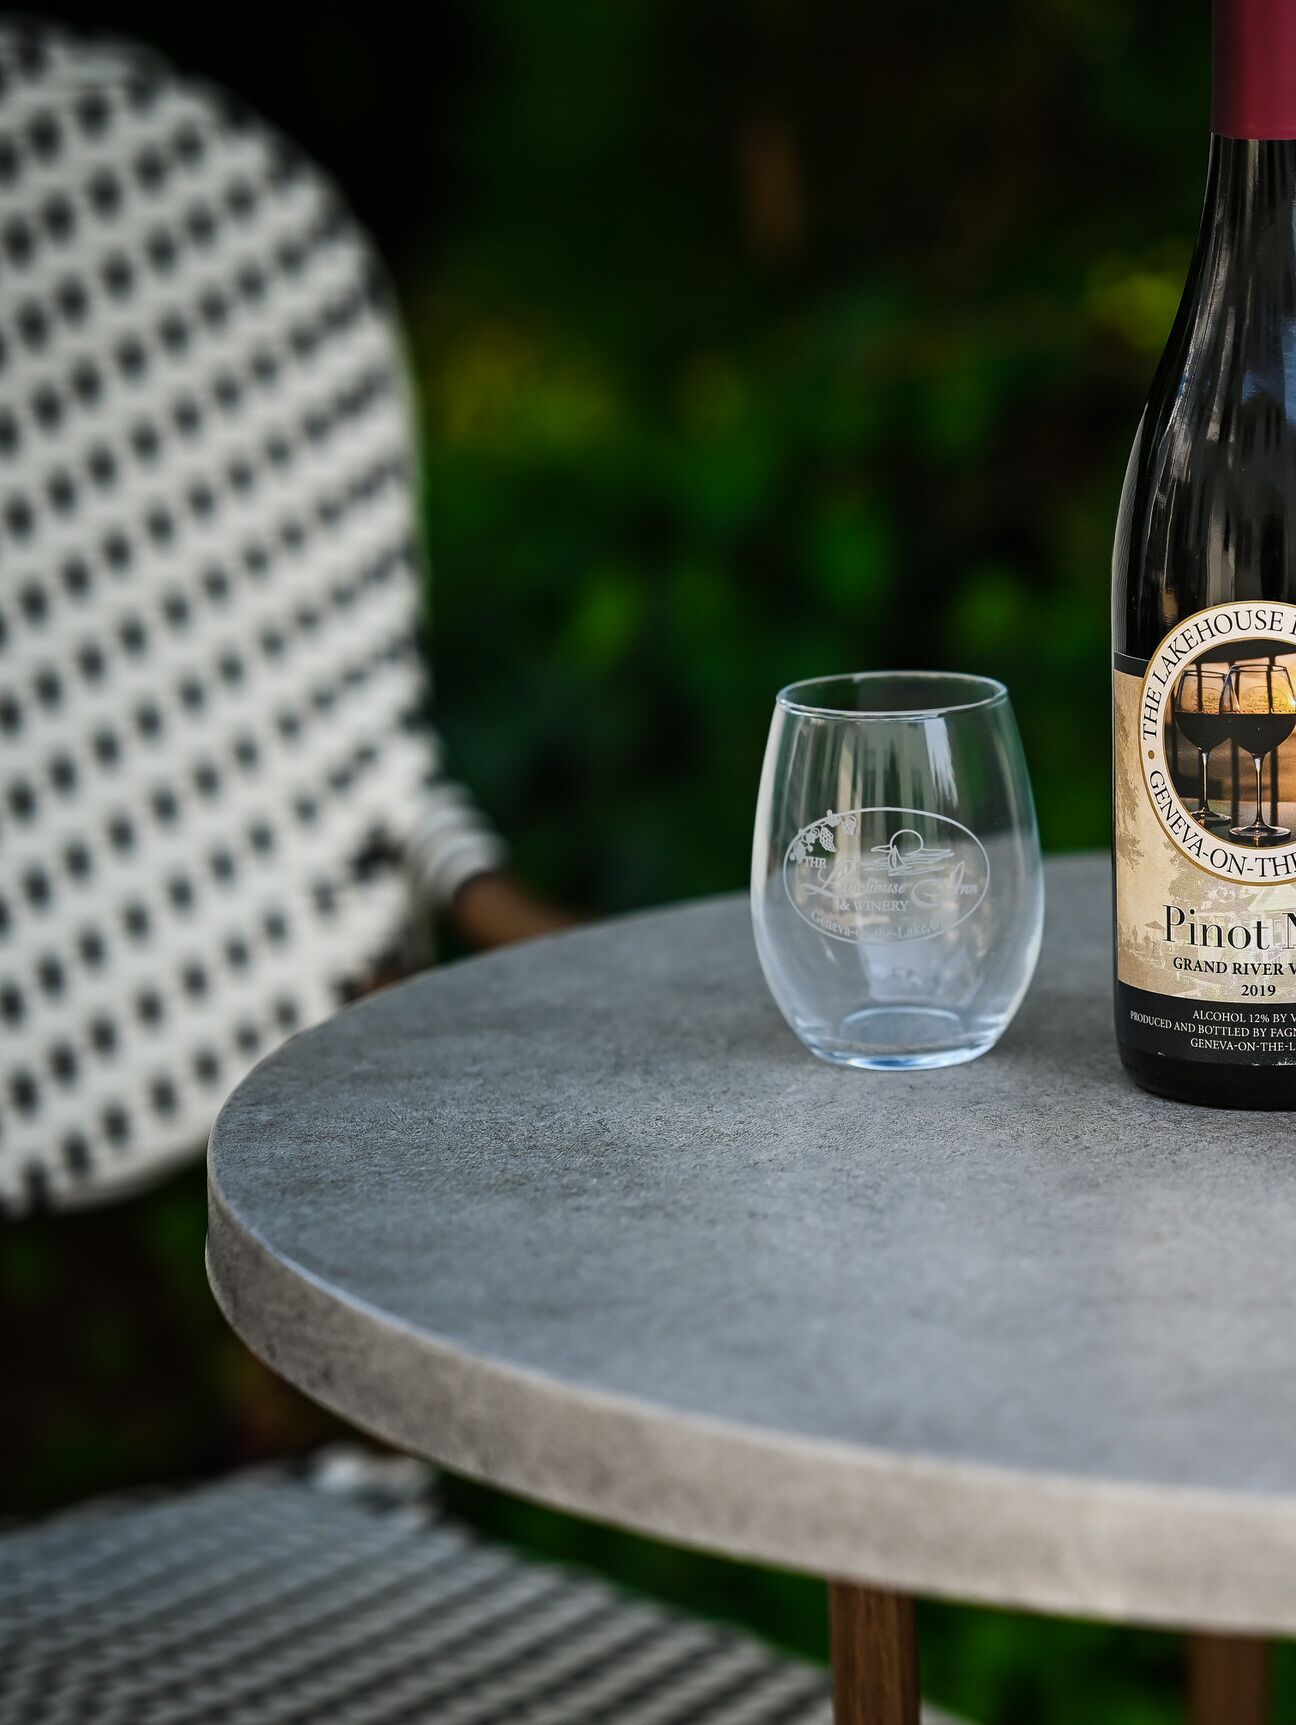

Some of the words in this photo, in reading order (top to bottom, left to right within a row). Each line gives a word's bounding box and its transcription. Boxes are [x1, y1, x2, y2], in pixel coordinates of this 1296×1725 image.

[1142, 687, 1162, 741] THE
[1152, 609, 1284, 688] LAKEHOUSE
[804, 856, 827, 869] THE
[800, 859, 907, 898] Lhouse
[853, 900, 910, 912] WINERY
[1162, 904, 1270, 950] Pinot
[1173, 956, 1228, 975] GRAND
[1232, 962, 1284, 976] RIVER
[1240, 984, 1277, 997] 2019
[1130, 1010, 1172, 1030] PRODUCED
[1173, 1021, 1196, 1033] AND
[1198, 1024, 1250, 1038] BOTTLED
[1252, 1027, 1268, 1038] BY
[1192, 1010, 1247, 1024] ALCOHOL
[1249, 1013, 1270, 1024] 12%
[1273, 1013, 1288, 1023] BY
